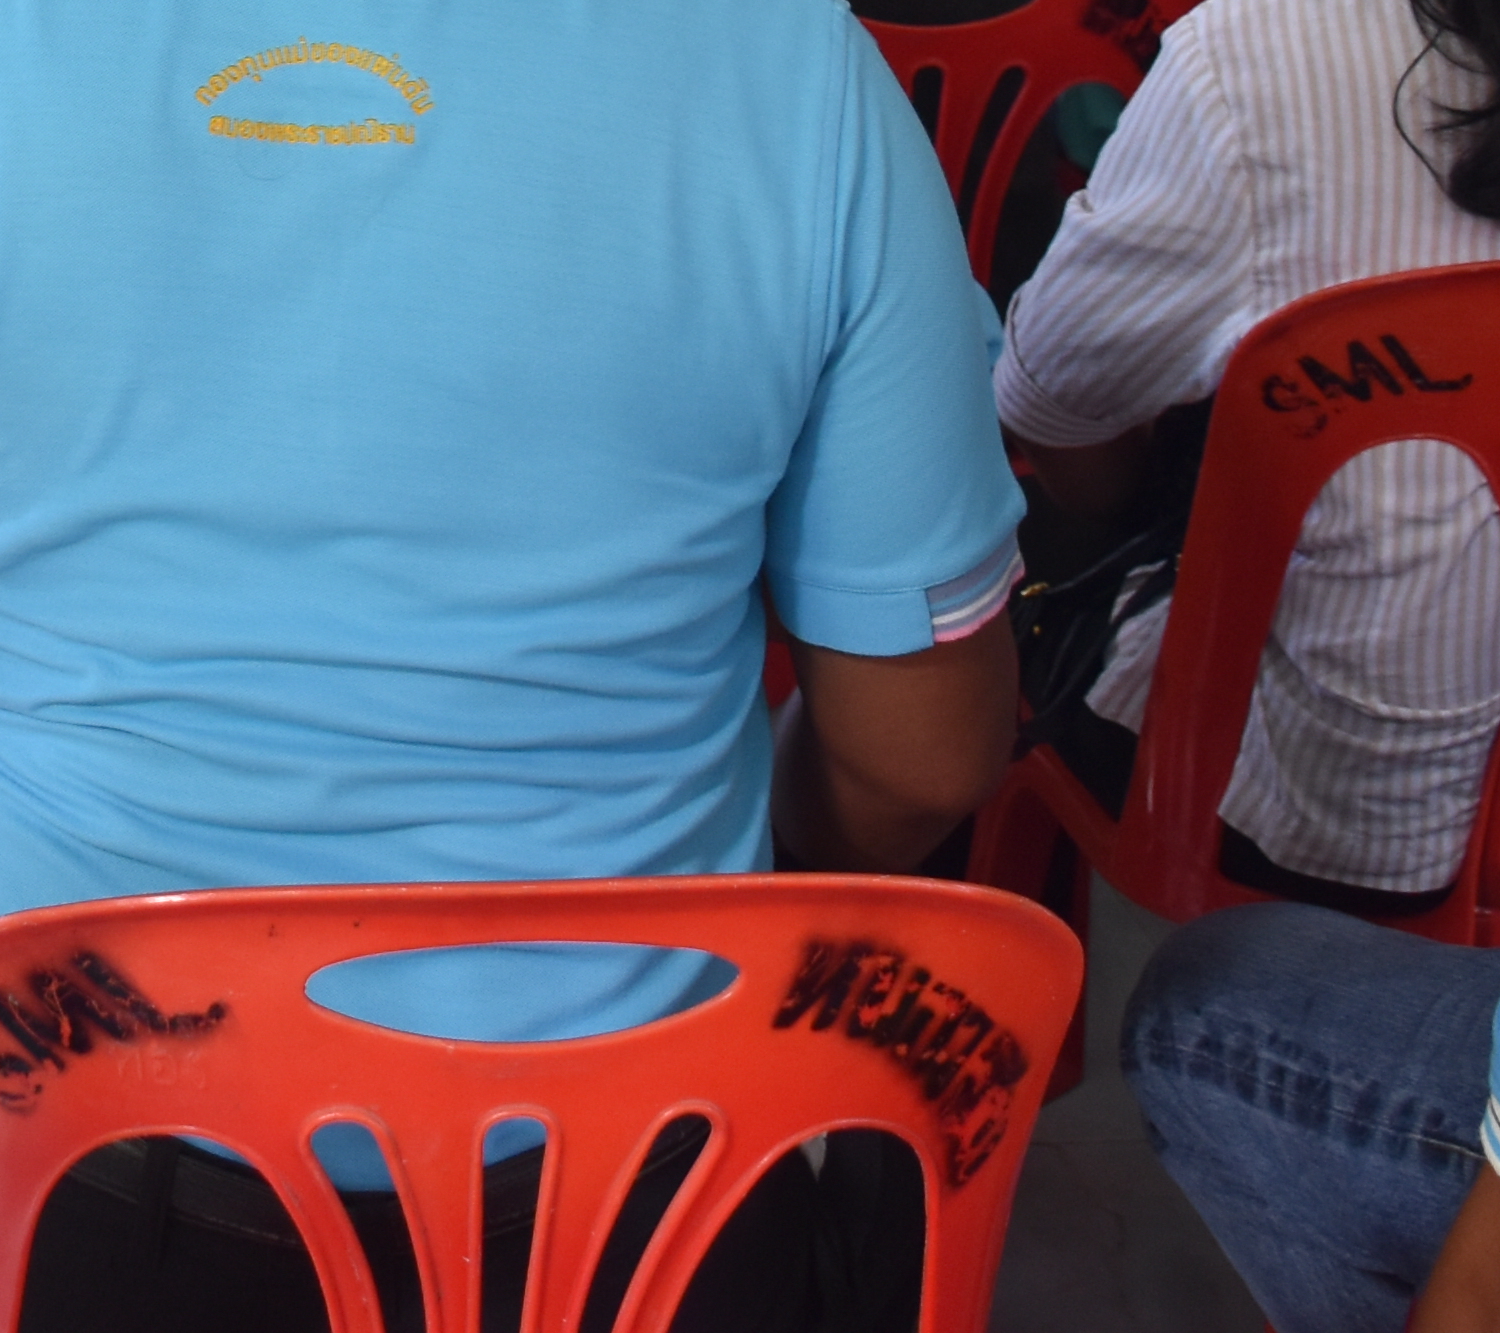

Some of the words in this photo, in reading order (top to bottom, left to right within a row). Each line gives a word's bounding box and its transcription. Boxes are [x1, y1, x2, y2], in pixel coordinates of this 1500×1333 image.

[193, 35, 435, 116] กองทุนแม่ของแผ่นดิน
[1262, 333, 1473, 437] SML
